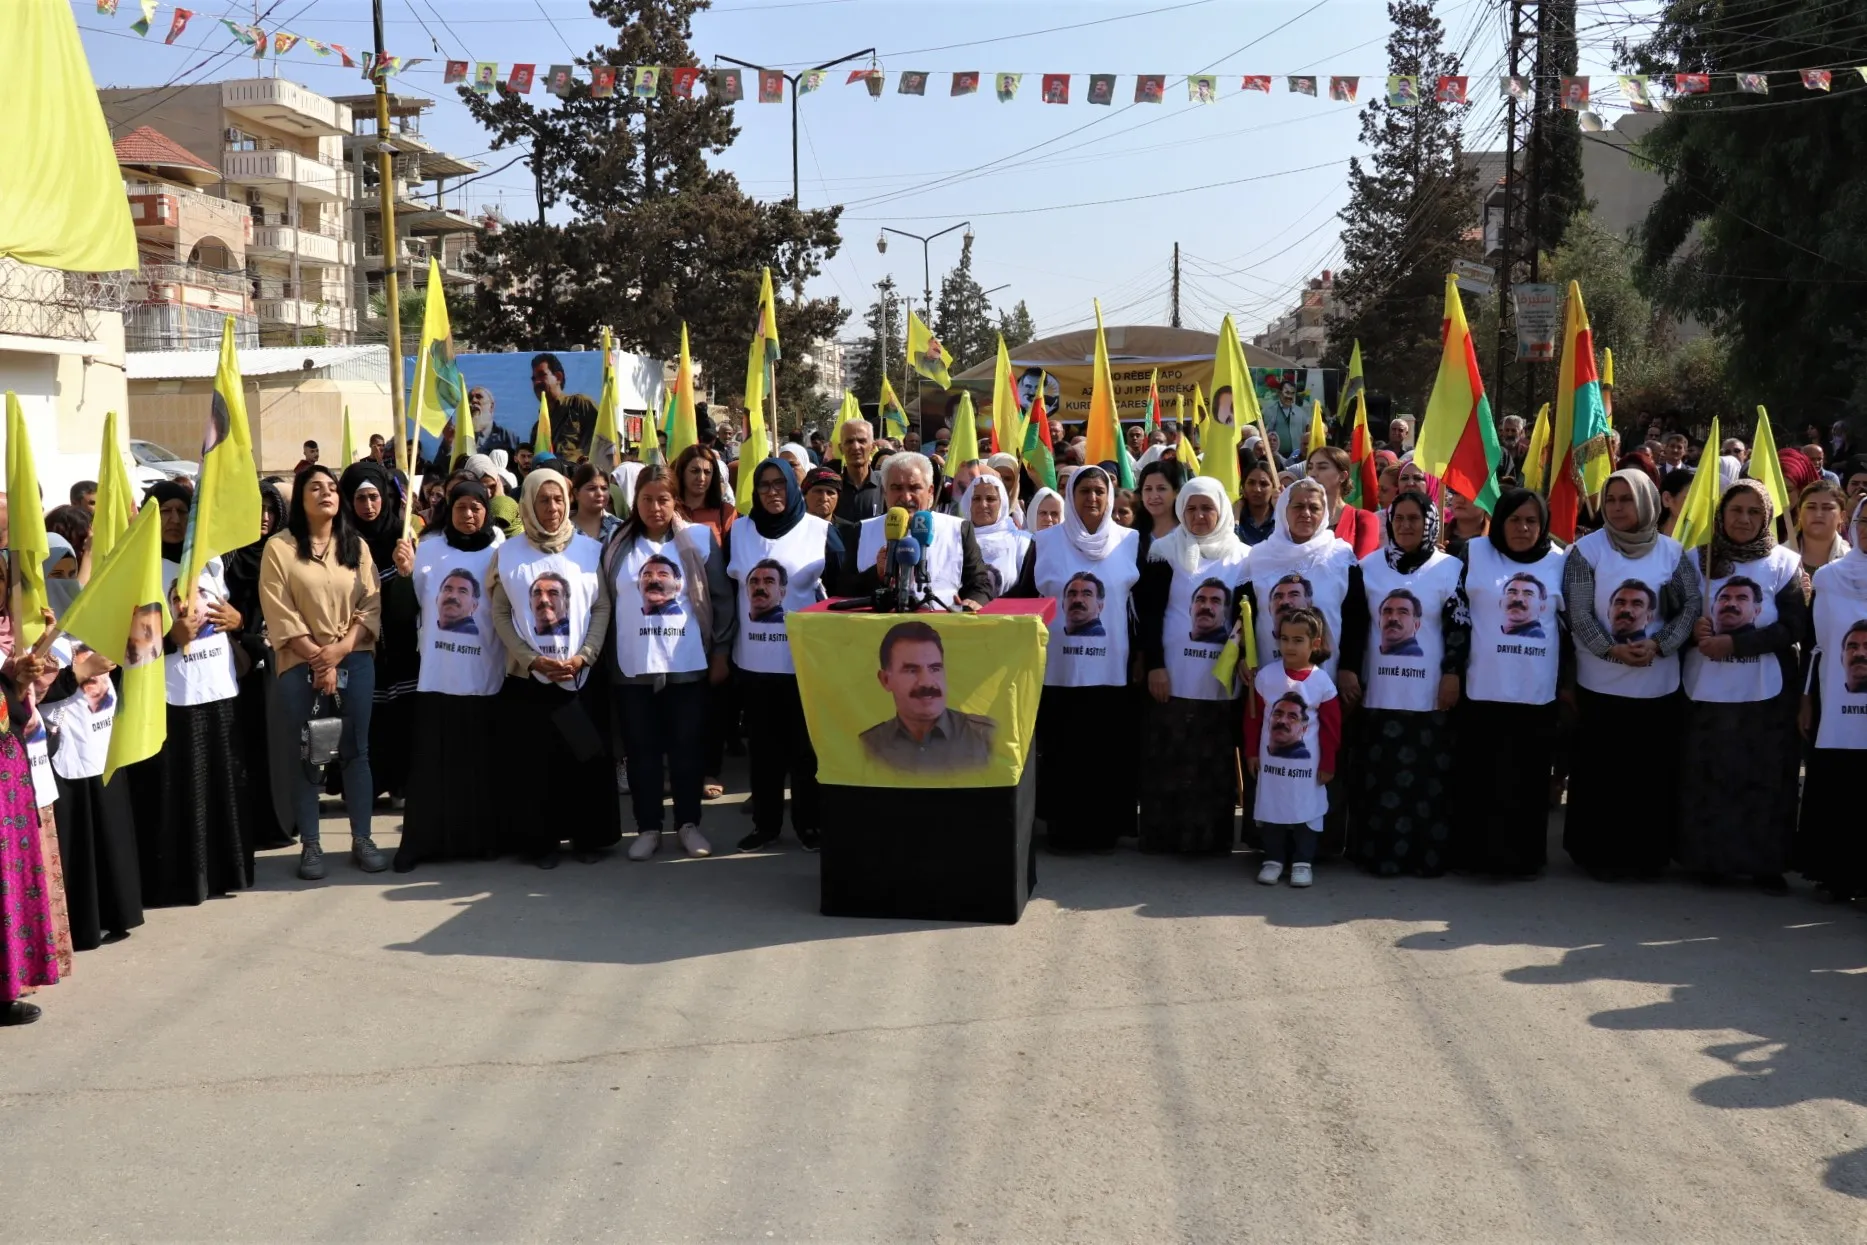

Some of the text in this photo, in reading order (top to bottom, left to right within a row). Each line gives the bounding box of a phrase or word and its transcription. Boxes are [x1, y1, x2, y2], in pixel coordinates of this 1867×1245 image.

[1161, 370, 1183, 380] APO
[1124, 386, 1133, 394] JI
[914, 516, 926, 529] R
[1183, 647, 1207, 659] DAYIKÊ
[1496, 644, 1522, 655] DAYIKÊ
[1378, 665, 1400, 677] DAYIKÊ
[1264, 764, 1286, 777] DAYIKÊ
